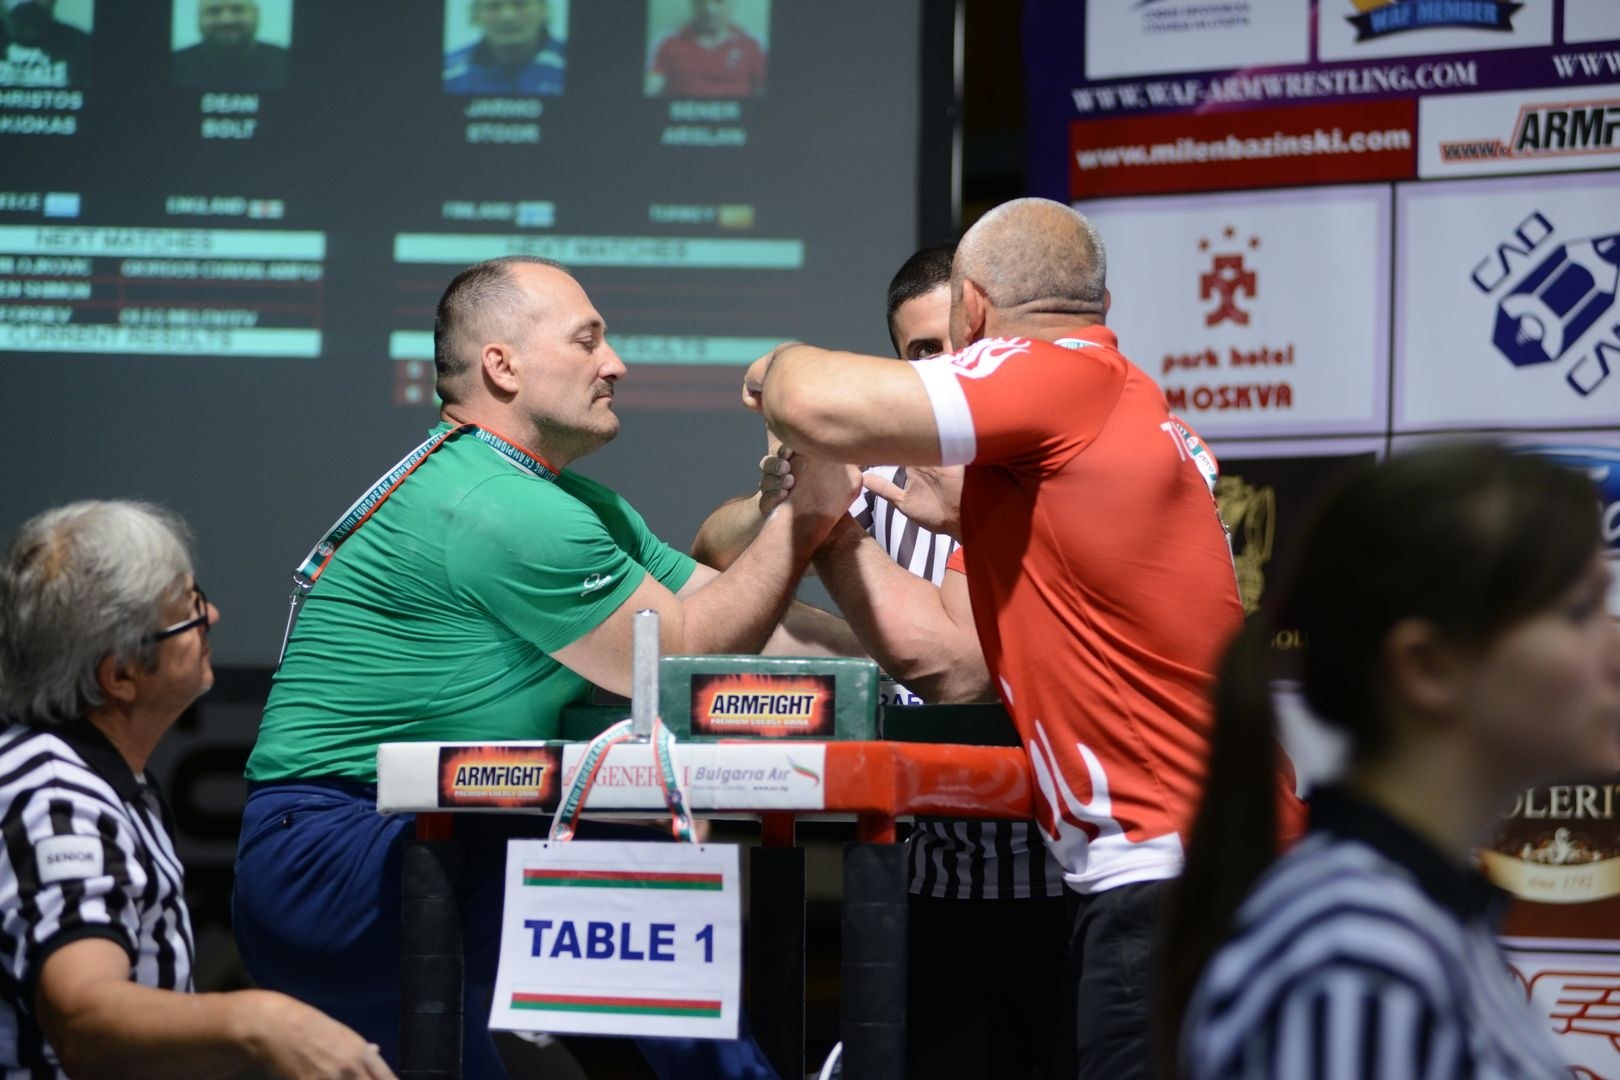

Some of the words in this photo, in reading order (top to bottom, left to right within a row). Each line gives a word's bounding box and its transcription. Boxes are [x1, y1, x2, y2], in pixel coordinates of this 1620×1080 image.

[1072, 60, 1478, 112] WWW.WAF-ARMWRESTLING.COM
[1075, 127, 1411, 170] www.milenbazinski.com
[1161, 345, 1220, 375] park
[1229, 344, 1294, 368] hotel
[1164, 382, 1293, 411] MOSKVA
[475, 427, 536, 470] CHAMPIONSHIP
[352, 480, 392, 521] EUROPEAN
[711, 693, 815, 716] ARMFIGHT
[454, 765, 545, 786] ARMFIGHT
[595, 766, 690, 787] GENERI
[46, 851, 95, 864] SENIOR
[524, 920, 675, 962] TABLE
[695, 924, 713, 963] 1
